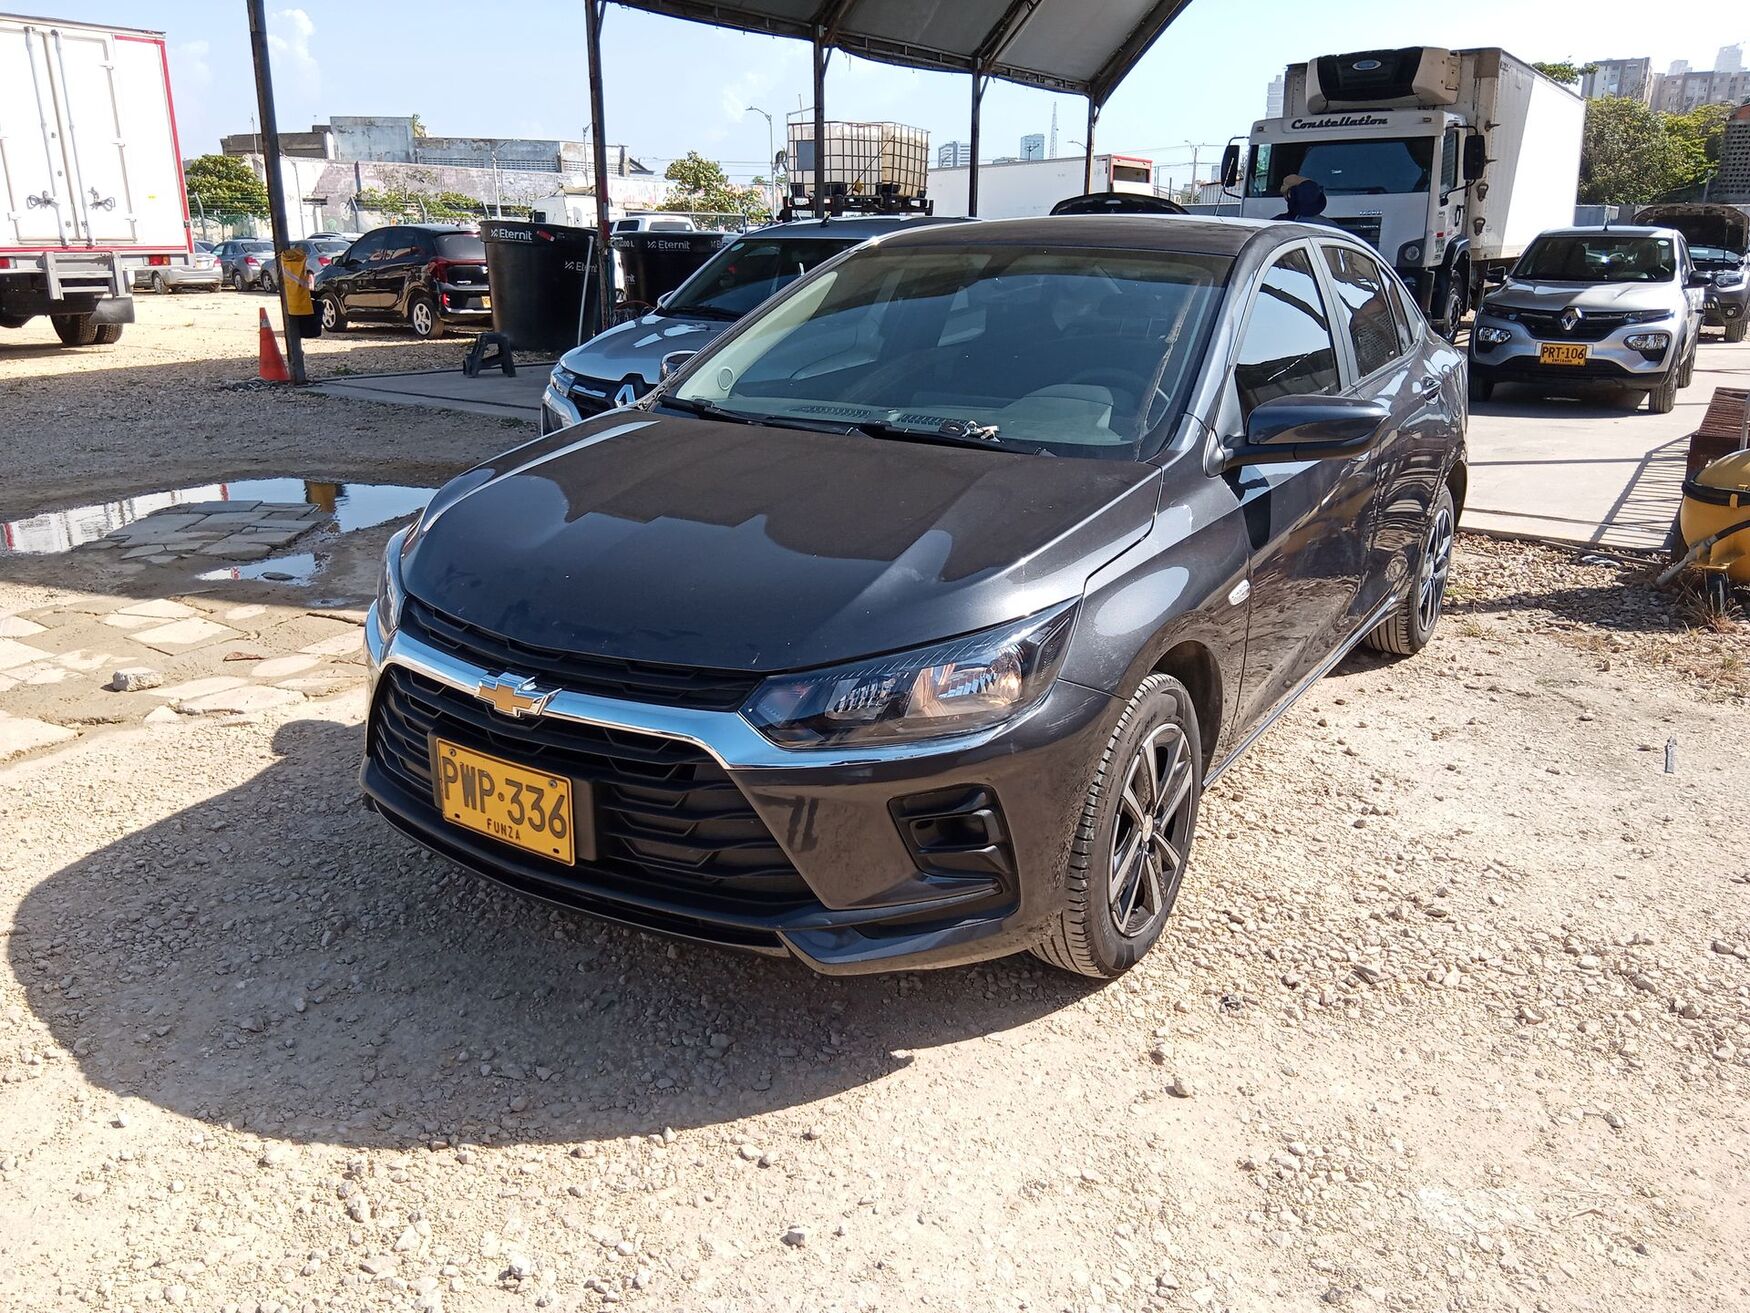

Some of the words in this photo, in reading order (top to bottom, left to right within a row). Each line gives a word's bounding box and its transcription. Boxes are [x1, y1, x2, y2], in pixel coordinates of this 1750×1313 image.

[1291, 115, 1388, 129] Constellation
[500, 229, 532, 240] Eternit
[658, 240, 691, 250] Eternit
[486, 818, 521, 841] FUNZA
